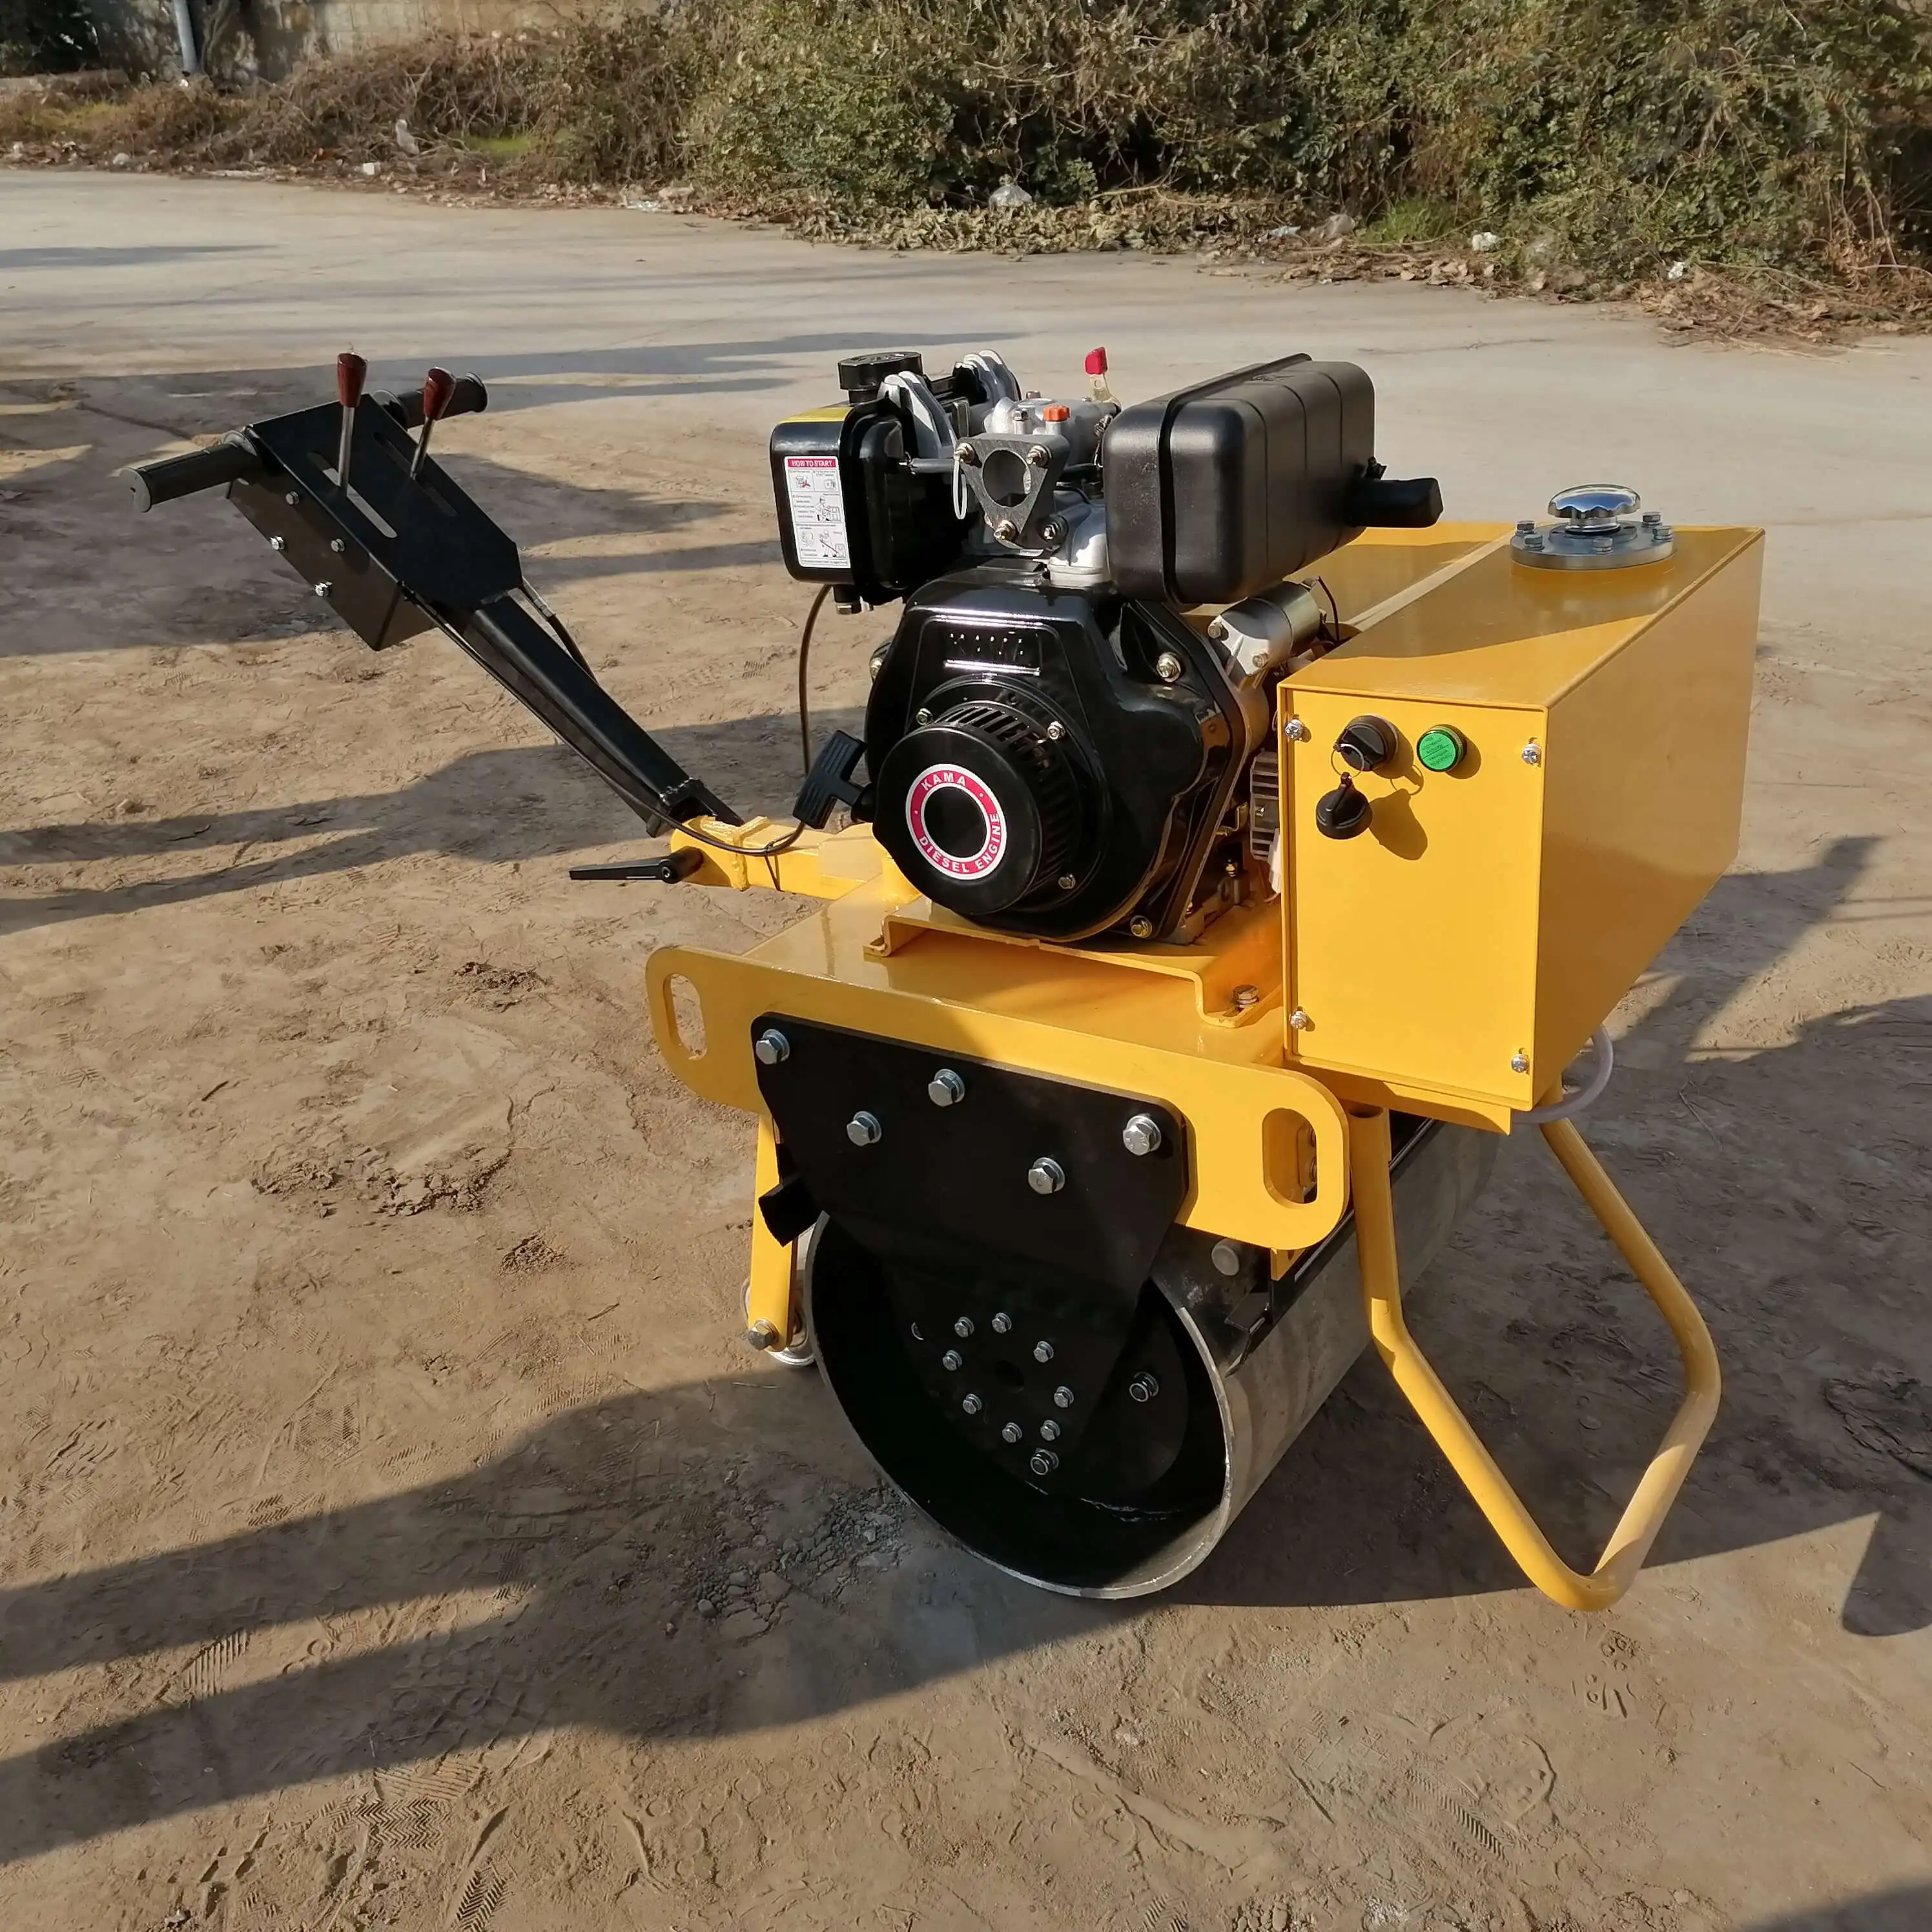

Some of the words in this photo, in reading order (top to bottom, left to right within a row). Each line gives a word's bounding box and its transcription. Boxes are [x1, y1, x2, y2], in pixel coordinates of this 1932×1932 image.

[921, 772, 967, 791] KAMA
[919, 836, 970, 873] DIESEL
[975, 812, 1002, 870] ENGINE
